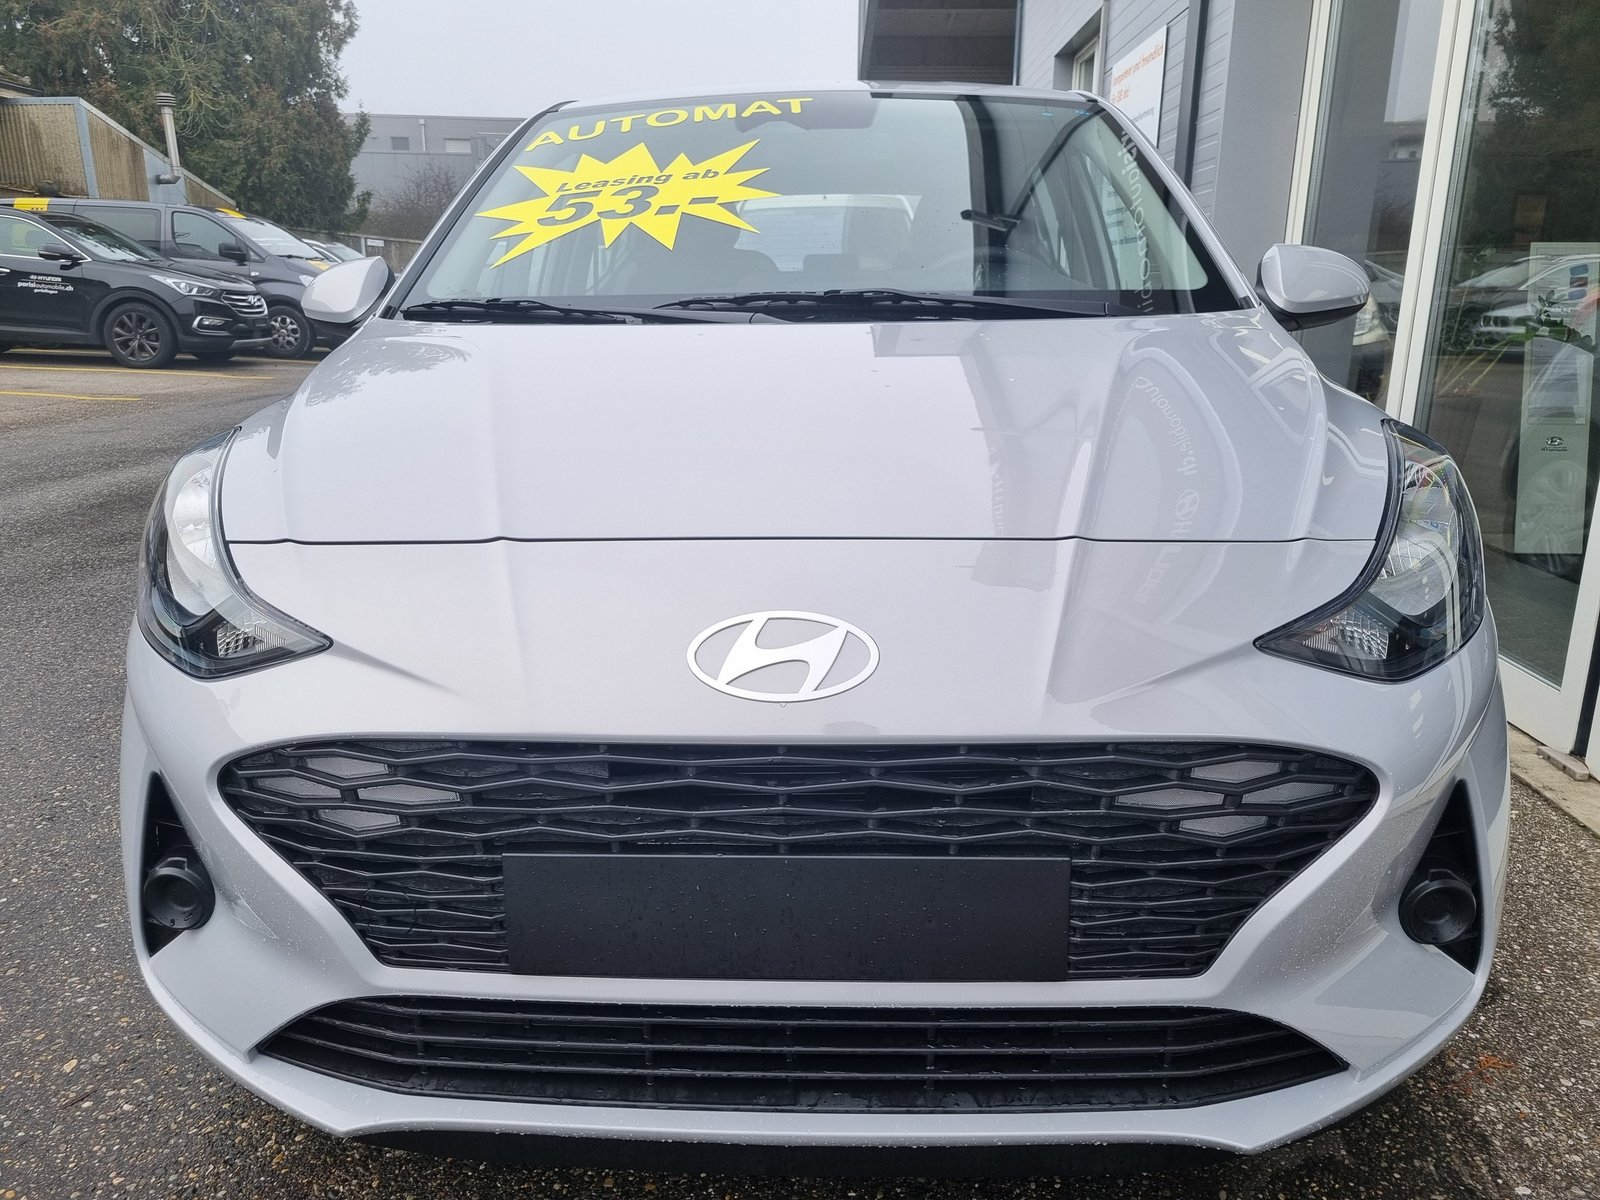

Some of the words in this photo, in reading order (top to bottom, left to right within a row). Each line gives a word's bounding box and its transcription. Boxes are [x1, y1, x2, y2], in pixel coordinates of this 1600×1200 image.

[524, 97, 814, 152] AUTOMAT
[555, 171, 672, 193] Leasing
[682, 168, 721, 181] ab
